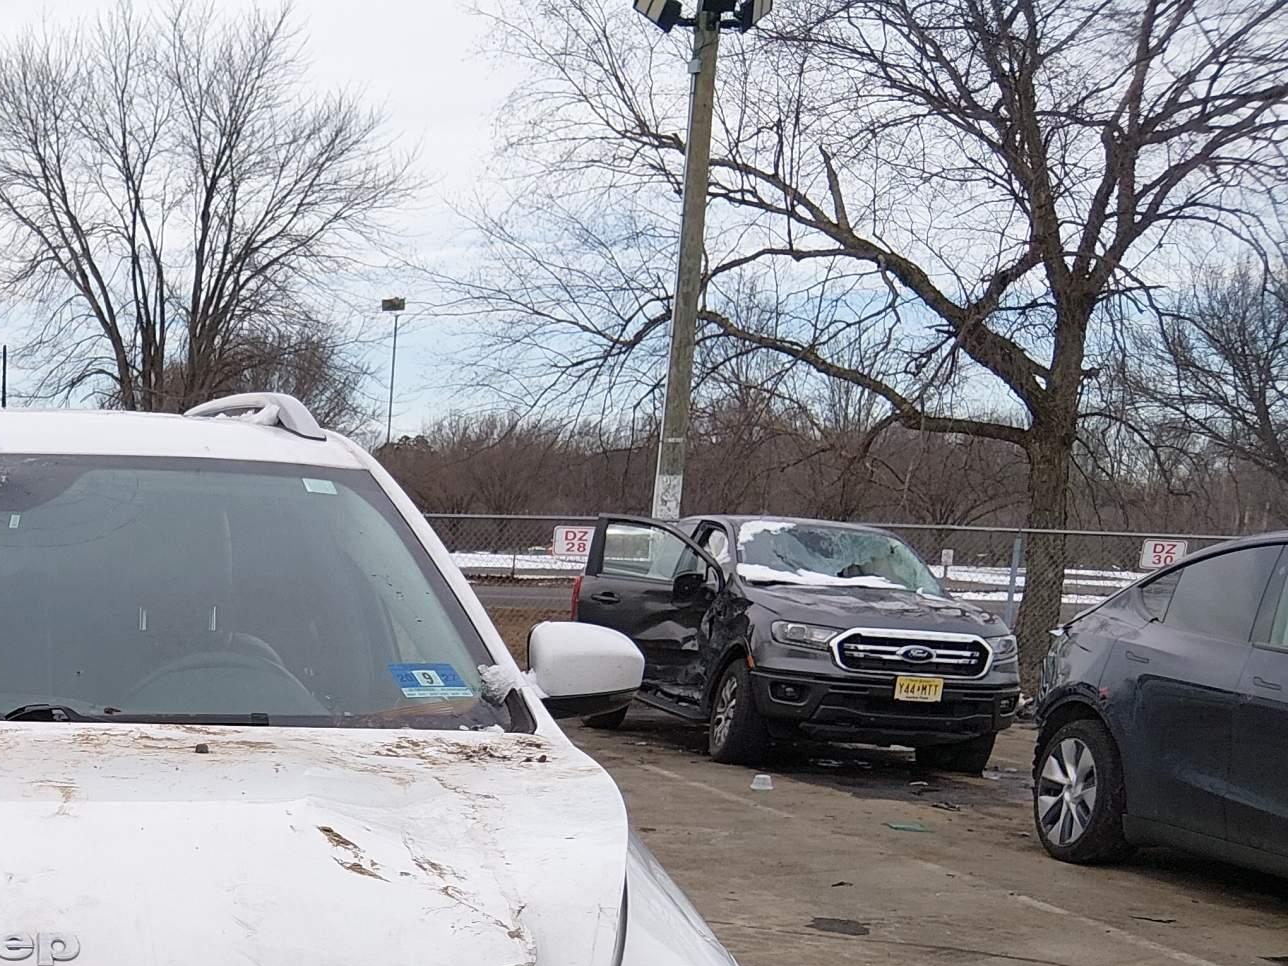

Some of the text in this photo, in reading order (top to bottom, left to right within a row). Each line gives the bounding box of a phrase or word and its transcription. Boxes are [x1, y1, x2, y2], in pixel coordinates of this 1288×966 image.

[564, 530, 588, 541] DZ
[566, 542, 587, 553] 28
[1153, 543, 1177, 554] DZ
[1152, 555, 1174, 565] 30
[422, 672, 434, 684] 9
